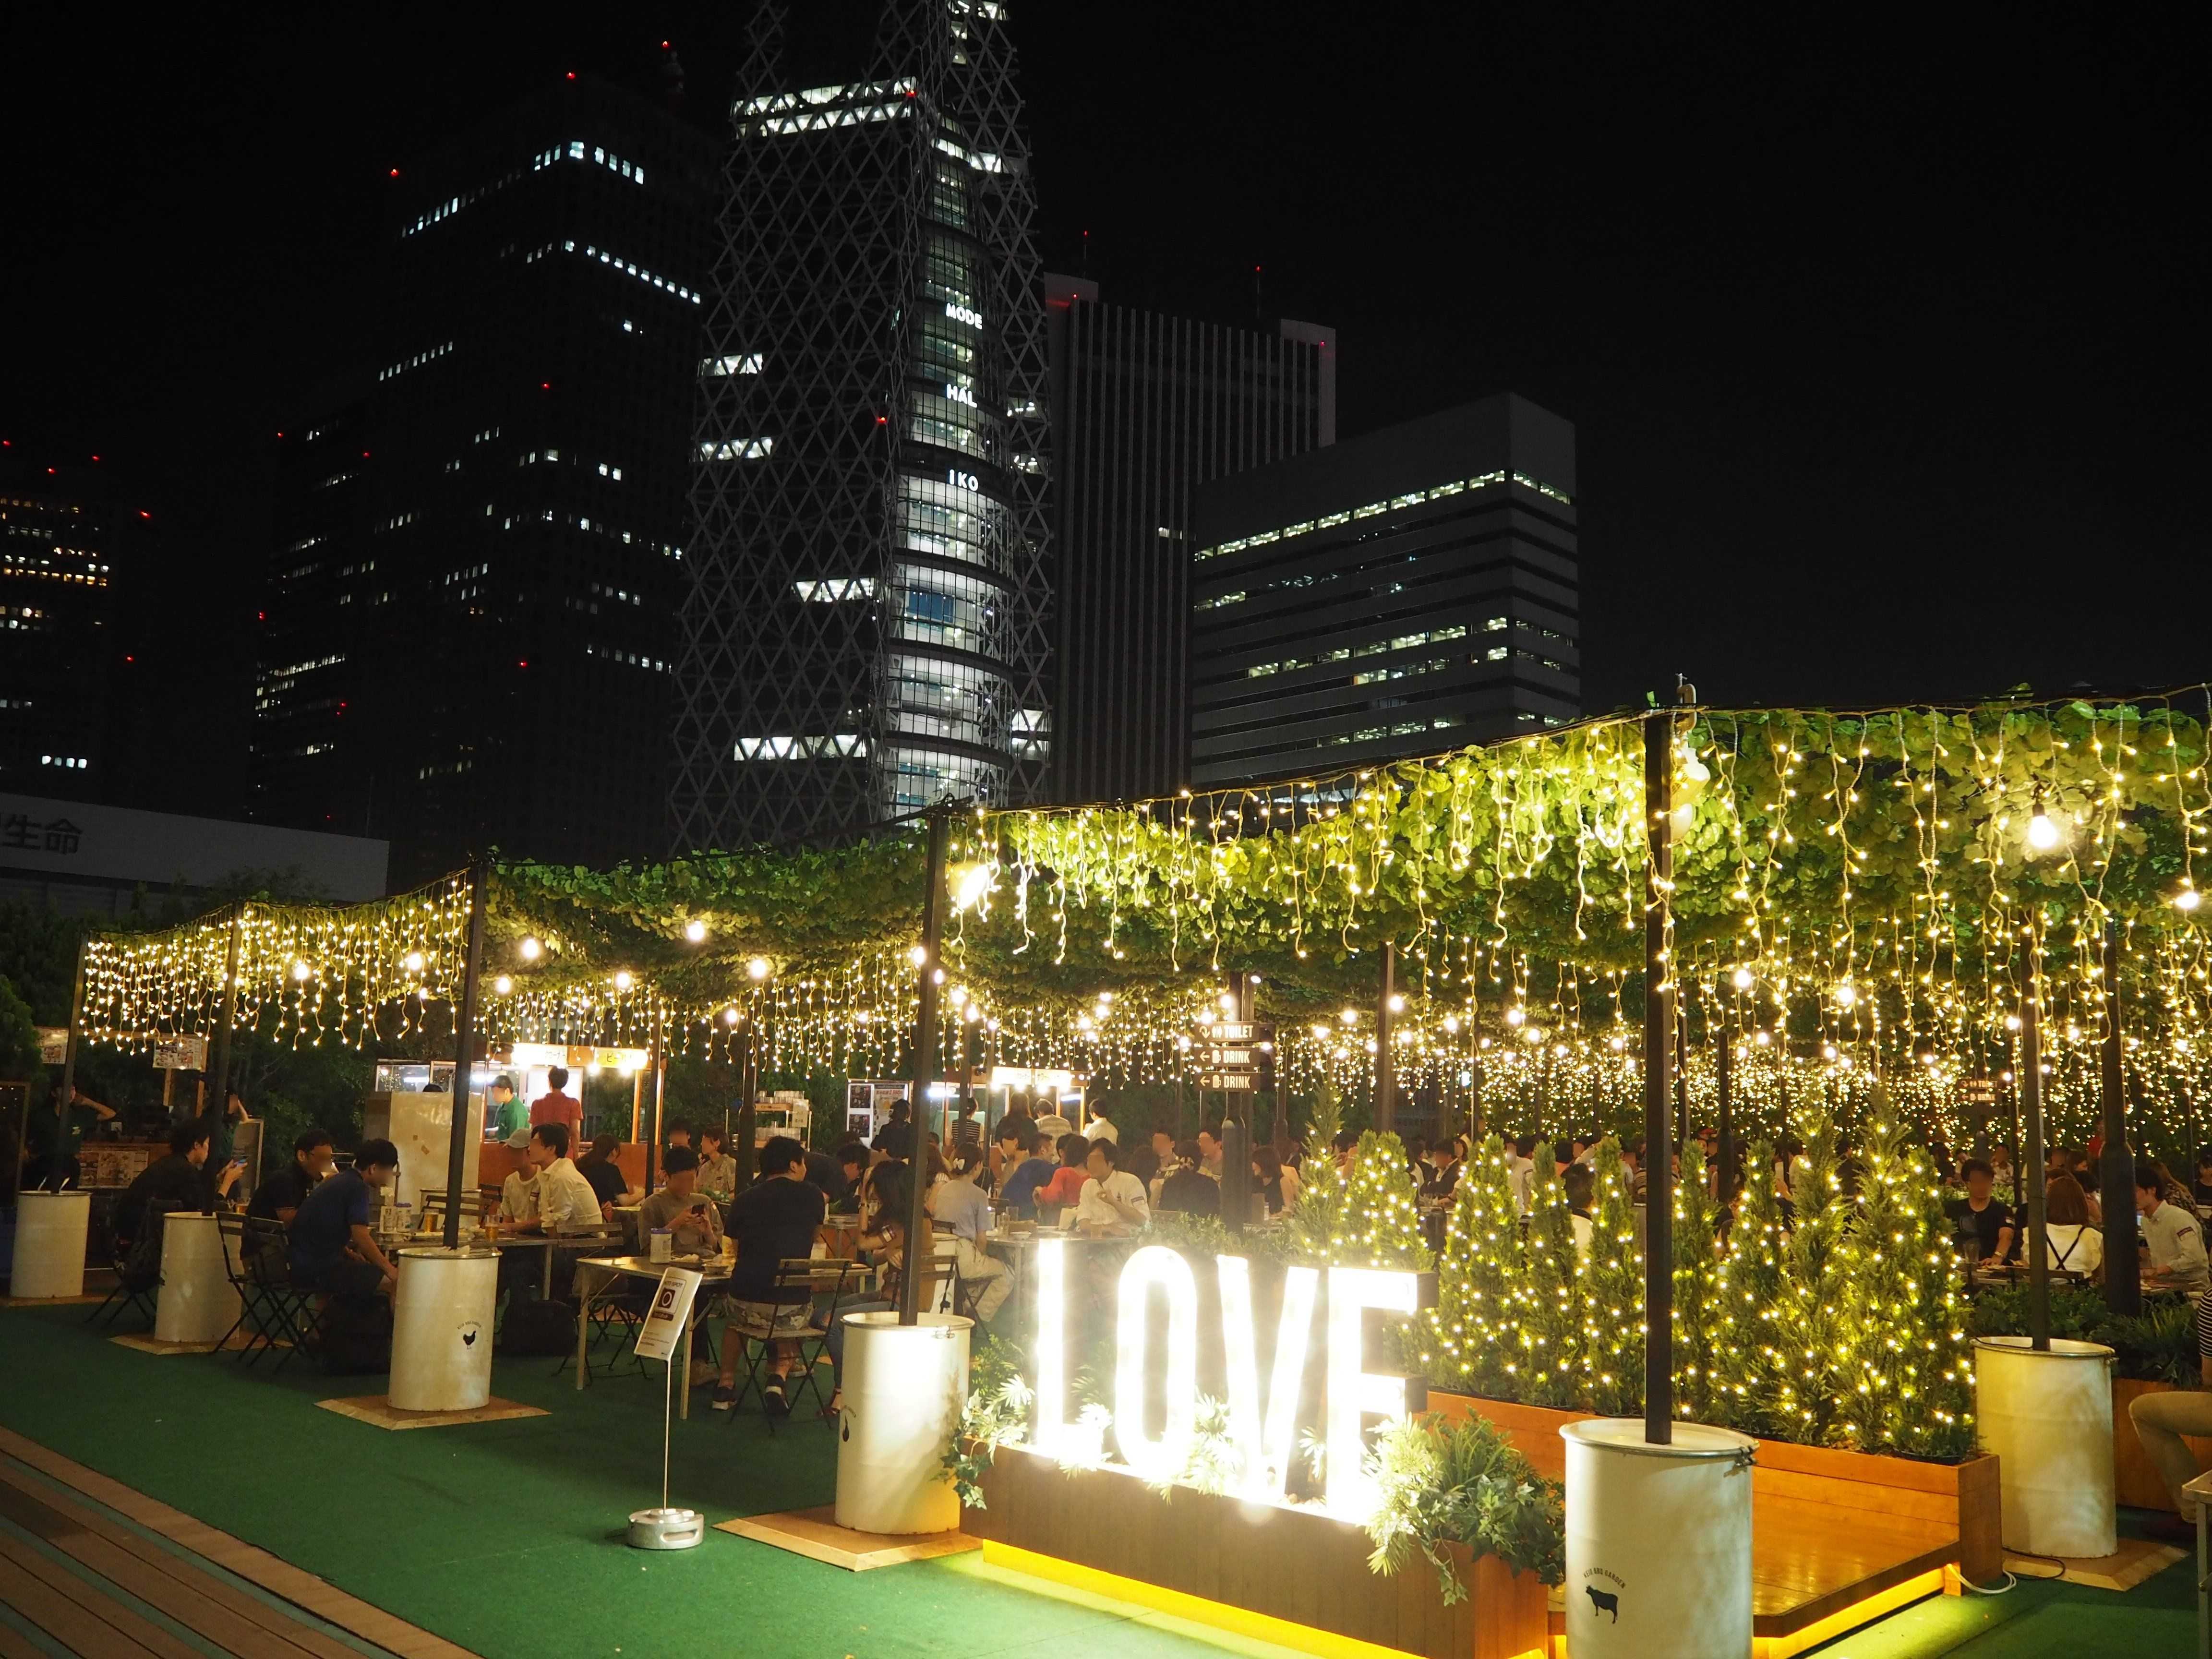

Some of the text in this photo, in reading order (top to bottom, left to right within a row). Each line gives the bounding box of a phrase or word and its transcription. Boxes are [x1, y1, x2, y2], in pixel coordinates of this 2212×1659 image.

[946, 302, 983, 330] MODE
[947, 384, 977, 409] HAL
[0, 812, 83, 854] 生命
[1224, 1025, 1253, 1038] TOILET
[1223, 1050, 1250, 1063] DRINK
[1224, 1076, 1250, 1088] DRINK
[1034, 1238, 1421, 1526] LOVE
